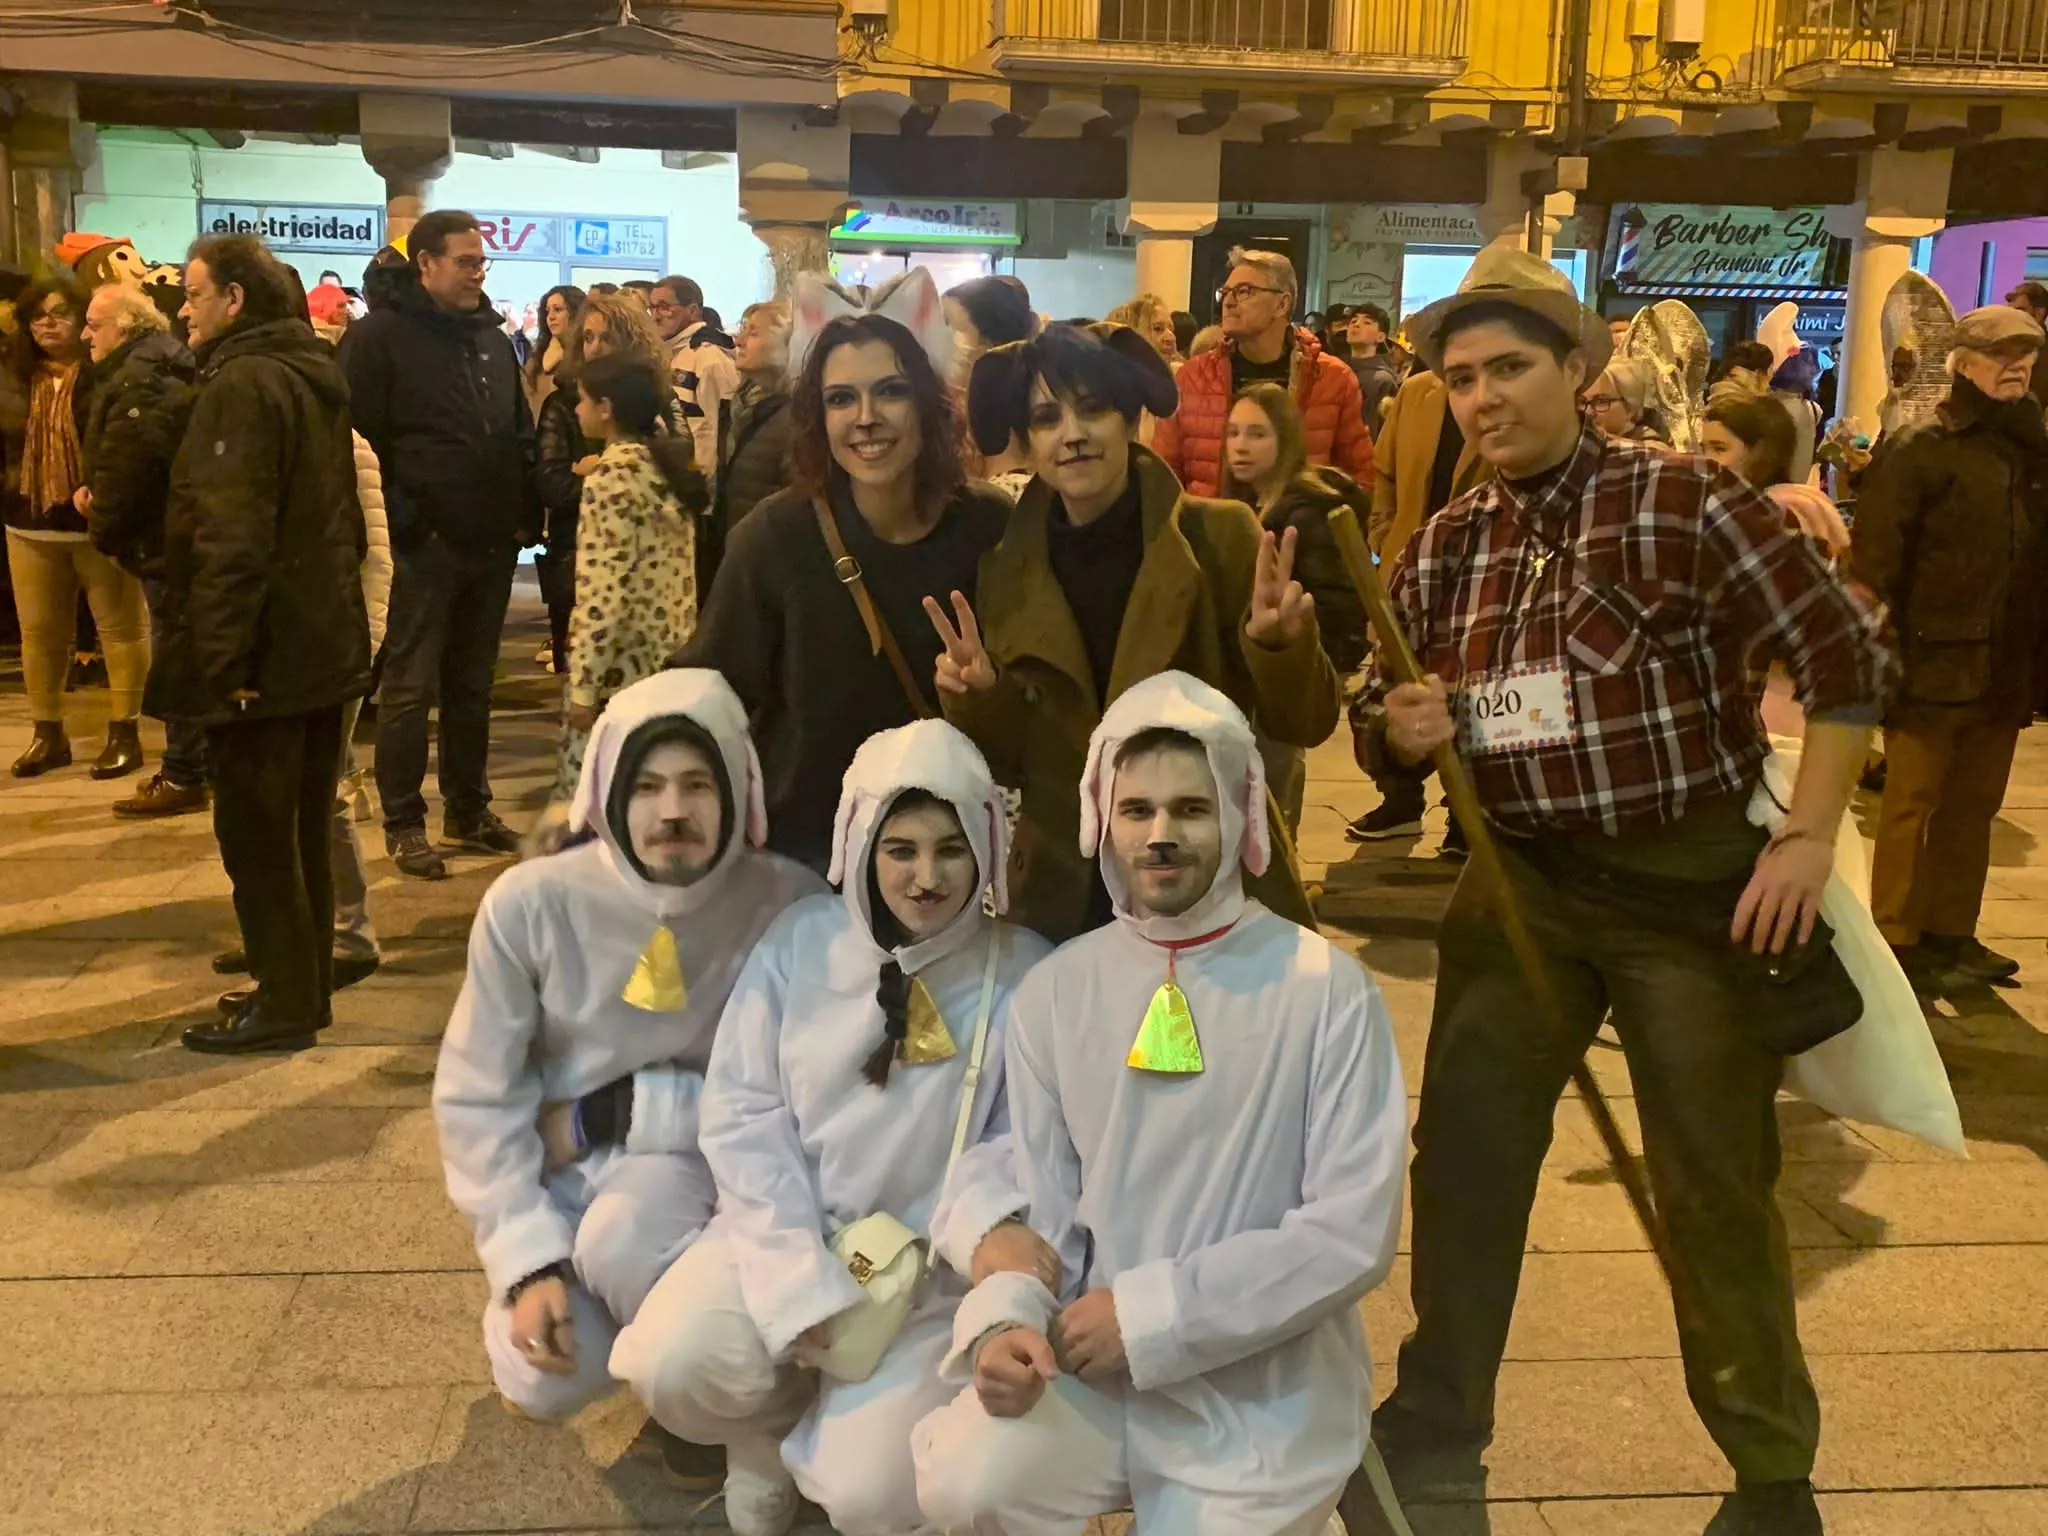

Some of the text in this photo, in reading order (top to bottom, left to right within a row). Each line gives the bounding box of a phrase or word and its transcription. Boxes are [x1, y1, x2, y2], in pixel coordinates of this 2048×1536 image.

[212, 212, 372, 241] electricidad
[1653, 213, 1771, 250] Barber
[1778, 252, 1808, 278] Jr.
[1476, 689, 1522, 719] 020
